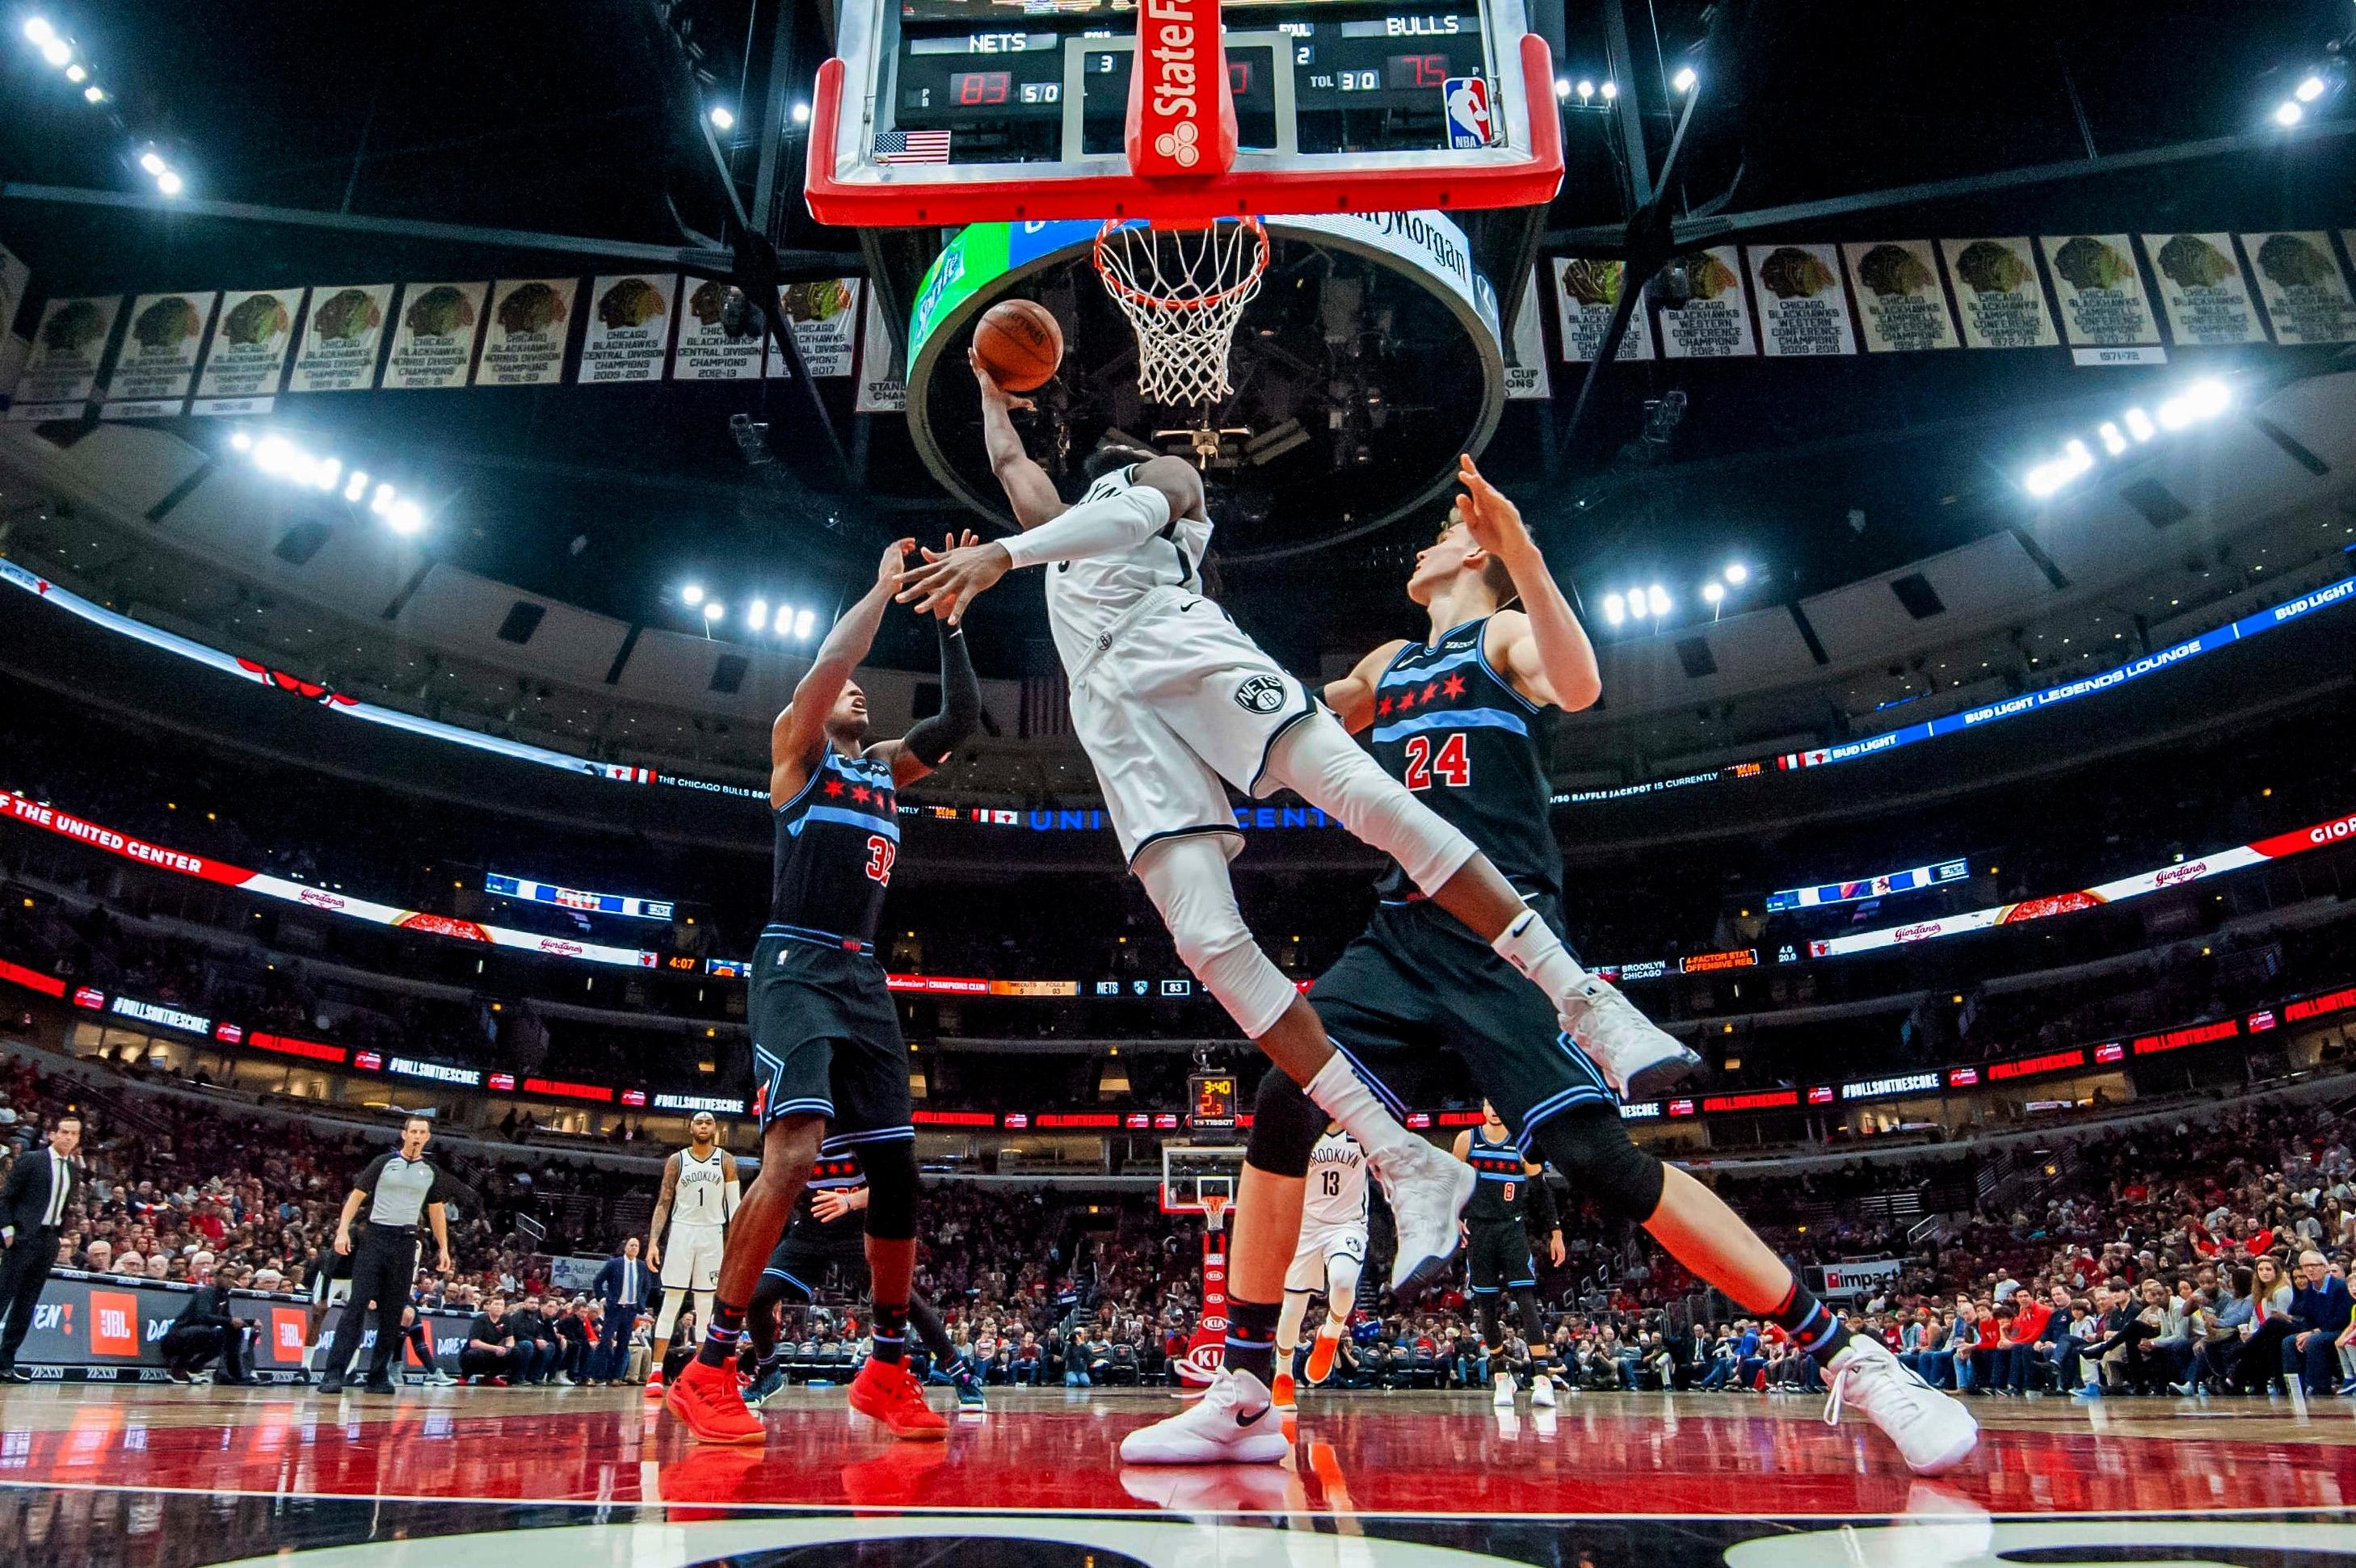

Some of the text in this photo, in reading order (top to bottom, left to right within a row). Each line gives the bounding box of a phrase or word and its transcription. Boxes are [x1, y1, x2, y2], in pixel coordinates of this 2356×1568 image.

[1386, 15, 1458, 36] BULLS
[970, 33, 1026, 53] NETS
[1297, 47, 1310, 64] 2
[1100, 56, 1113, 72] 3
[1406, 56, 1446, 86] 75
[1311, 72, 1375, 90] TOL 3/0
[960, 74, 1008, 104] 83
[1455, 136, 1477, 148] NBA
[1580, 306, 1611, 316] CHICA
[1687, 301, 1725, 310] HICAGO
[1779, 300, 1824, 310] CHICAGO
[1668, 309, 1740, 321] BLACKHAWKS
[1768, 309, 1840, 319] BLACKHAWKS
[700, 326, 725, 336] CHIC
[1679, 320, 1731, 330] WESTERN
[607, 330, 648, 339] CHICAGO
[1672, 327, 1743, 338] CONFERENCE
[1771, 328, 1841, 338] CONFERENCE
[592, 339, 659, 350] BLACKHAWKS
[1678, 338, 1740, 347] CHAMPIONS
[1778, 337, 1840, 346] CHAMPIONS
[583, 348, 665, 360] CENTRAL DIVISION
[677, 347, 761, 356] CENTRAL DIVISION
[814, 344, 852, 354] DIVISION
[1690, 347, 1731, 356] 2012-13
[2099, 351, 2140, 361] 1971-72
[595, 360, 650, 371] CHAMPIONS
[690, 359, 747, 368] CHAMPIONS
[697, 368, 738, 378] 2012-13
[1511, 369, 1538, 379] CUP
[869, 382, 906, 392] STAN
[2274, 579, 2356, 621] BUD LIGHT
[1963, 640, 2201, 725] BUD LIGHT LEGENDS LOUNGE
[1238, 675, 1281, 707] NETS
[1262, 692, 1277, 705] B
[1832, 734, 1897, 759] BUD LIGHT
[1405, 733, 1470, 792] 24
[658, 775, 750, 797] THE CHICAGO BULLS
[1571, 771, 1719, 802] RAFFLE JACKPOT IS CURRENTLY
[0, 793, 202, 873] F THE UNITED CENTER
[866, 834, 896, 887] 32
[1779, 945, 1793, 955] 4.0
[669, 956, 696, 970] 4:07
[1685, 950, 1751, 966] 4-FACTOR STAT
[1778, 952, 1797, 964] 20.0
[1622, 960, 1665, 973] BROOKLYN
[1685, 957, 1754, 973] OFFENSIVE REB
[1622, 969, 1663, 981] CHICAGO
[928, 980, 969, 990] CHAMPIONS
[969, 982, 987, 991] CLUB
[1096, 982, 1119, 995] NETS
[1169, 982, 1183, 993] 83
[1204, 1080, 1231, 1095] 3:40
[1842, 1072, 1940, 1099] #BULLSONTHESCORE
[681, 1171, 722, 1188] BROOKLYN
[1321, 1170, 1340, 1196] 13
[697, 1187, 704, 1207] 1
[1208, 1272, 1222, 1280] KIA
[1208, 1294, 1224, 1302] KIA
[99, 1309, 131, 1339] JBL
[1205, 1318, 1226, 1330] KIA
[280, 1322, 304, 1349] JBL
[1197, 1349, 1222, 1367] KI
